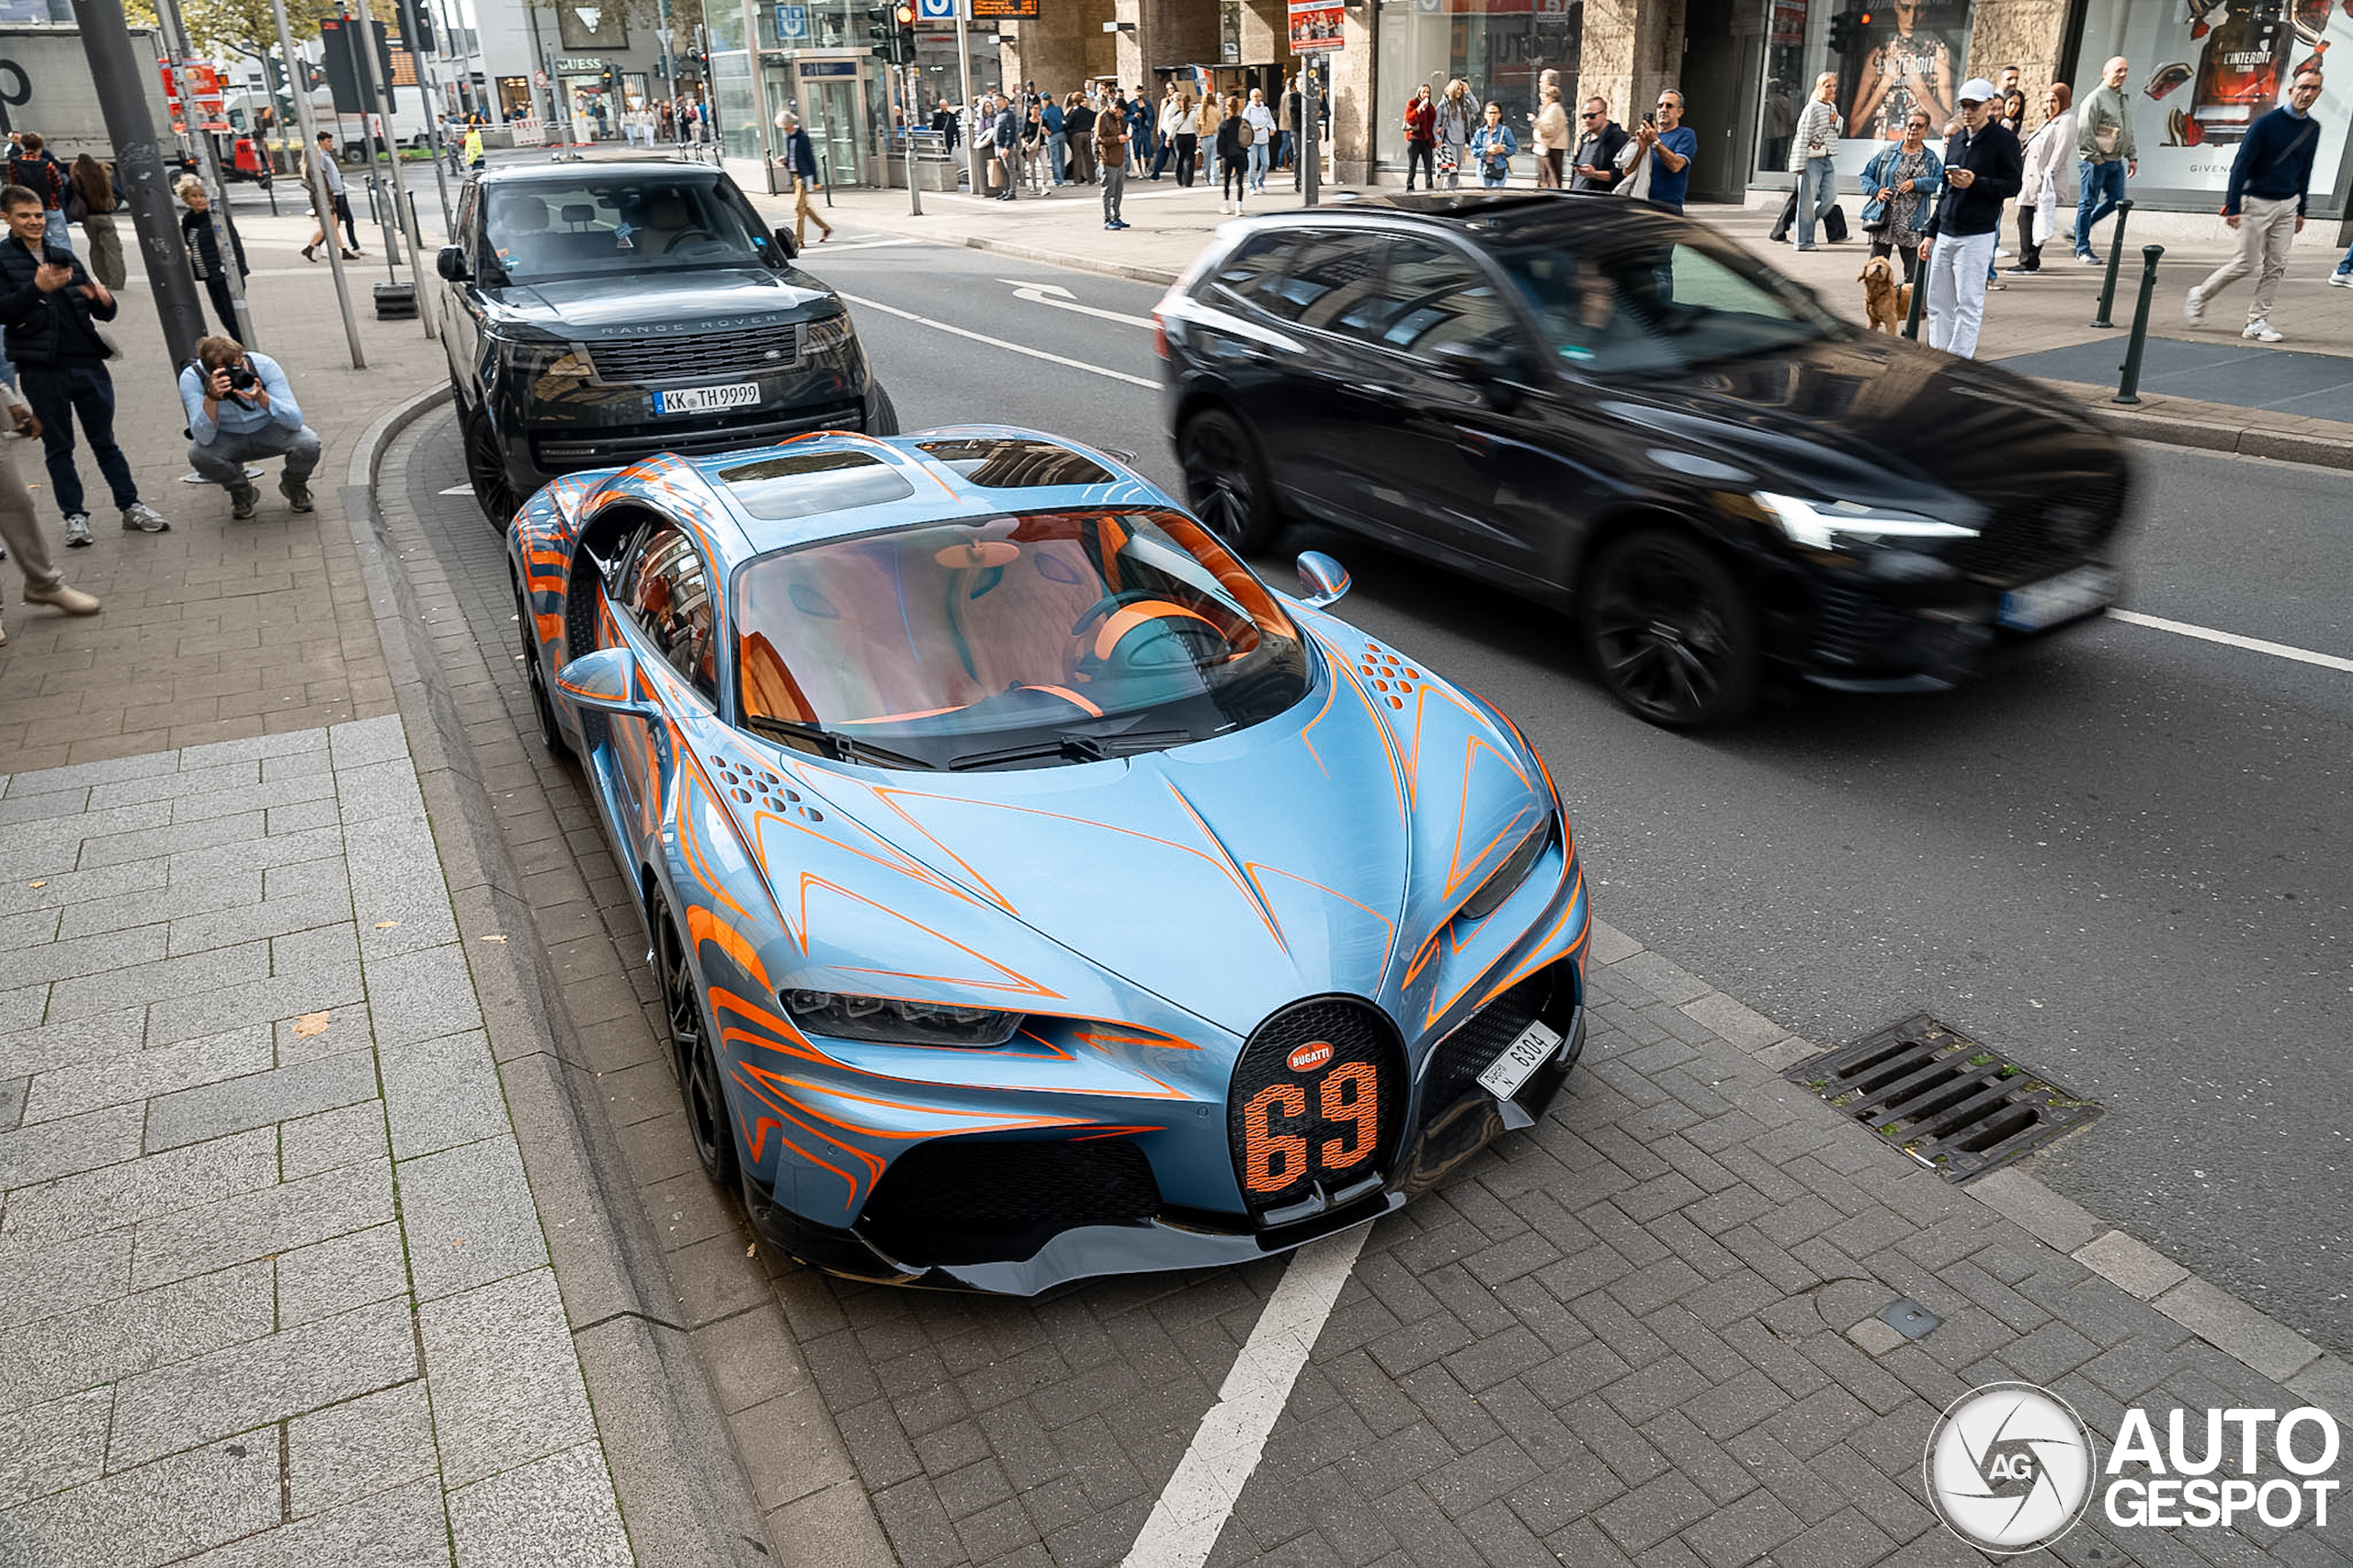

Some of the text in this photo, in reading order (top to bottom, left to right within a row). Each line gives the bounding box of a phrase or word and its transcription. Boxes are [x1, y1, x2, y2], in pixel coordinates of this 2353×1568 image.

[780, 8, 801, 36] U
[2223, 51, 2272, 65] L'INTERDIT
[2189, 165, 2229, 173] GIVEN
[601, 315, 779, 335] RANGE ROVER
[665, 392, 687, 410] KK
[1292, 1048, 1330, 1067] BUGATTI
[1510, 1032, 1549, 1067] 6304
[1244, 1062, 1378, 1192] 69
